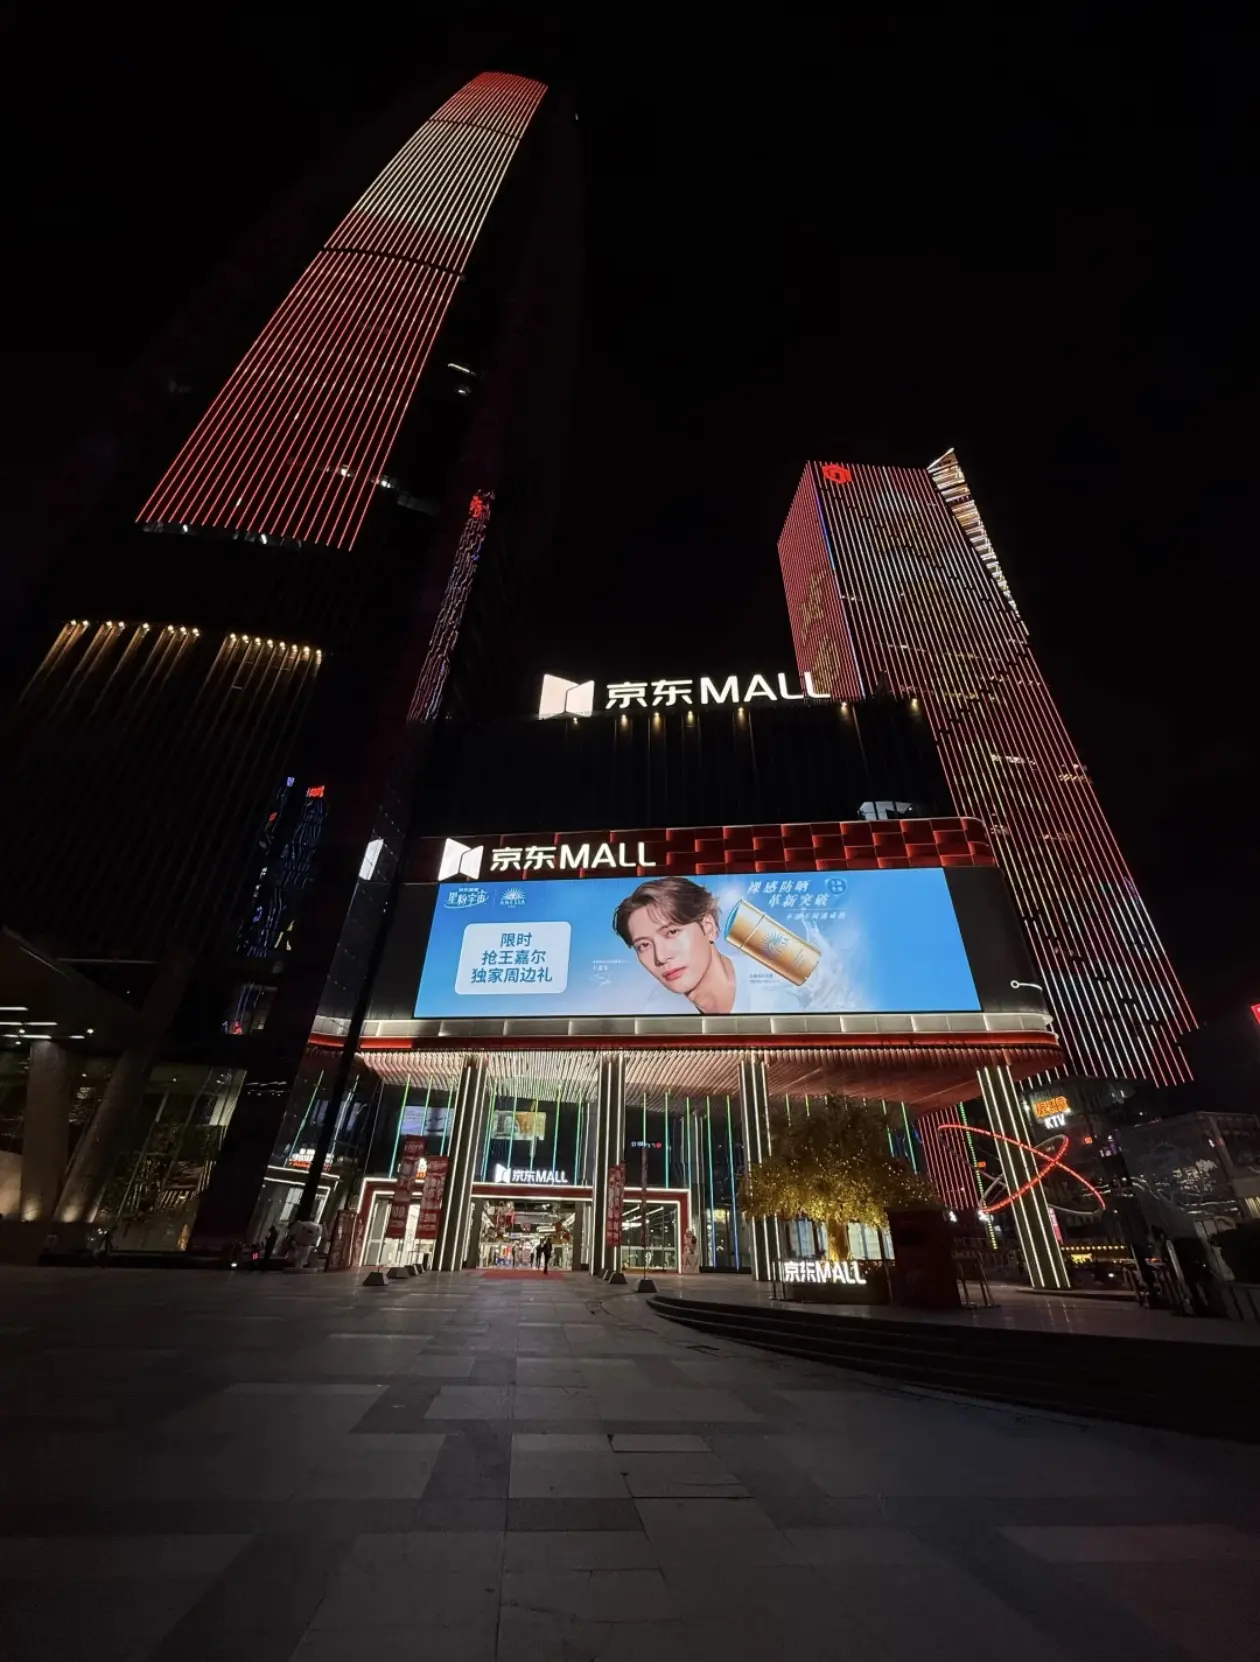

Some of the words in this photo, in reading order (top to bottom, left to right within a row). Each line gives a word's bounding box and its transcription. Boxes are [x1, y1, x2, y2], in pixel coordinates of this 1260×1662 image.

[605, 671, 831, 709] 京东MALL
[490, 842, 656, 871] 京东MALL
[500, 932, 532, 947] 限时
[481, 949, 546, 966] 抢王嘉尔
[470, 967, 553, 984] 独家周边礼
[1044, 1113, 1066, 1130] KTV
[512, 1169, 568, 1184] 京东MALL
[784, 1260, 867, 1285] 京东MALL
